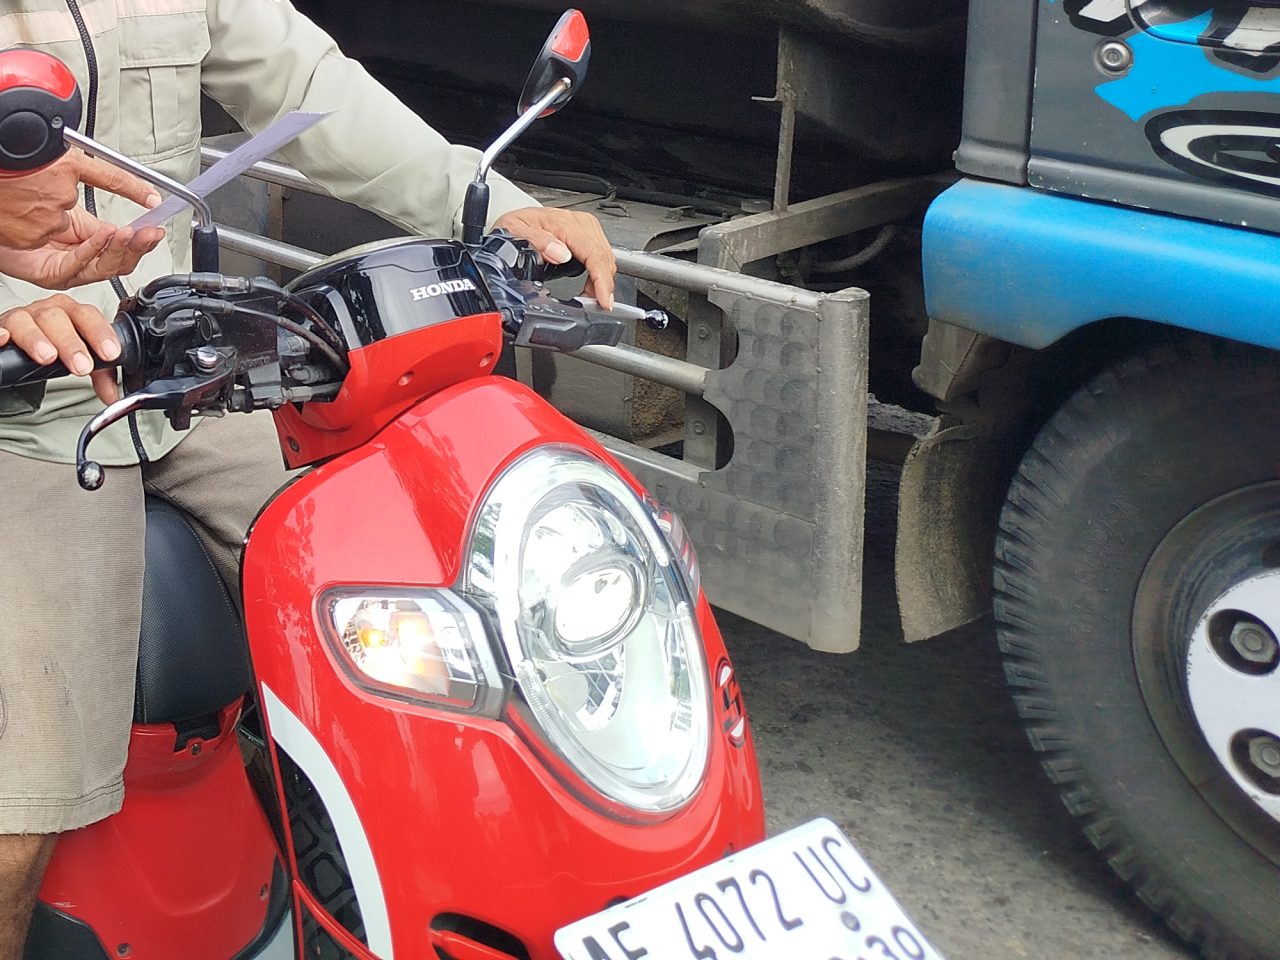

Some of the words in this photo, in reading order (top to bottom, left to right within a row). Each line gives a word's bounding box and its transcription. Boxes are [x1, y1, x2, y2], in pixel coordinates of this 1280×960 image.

[410, 279, 476, 302] HONDA
[674, 868, 804, 960] 4072
[792, 835, 872, 905] UC
